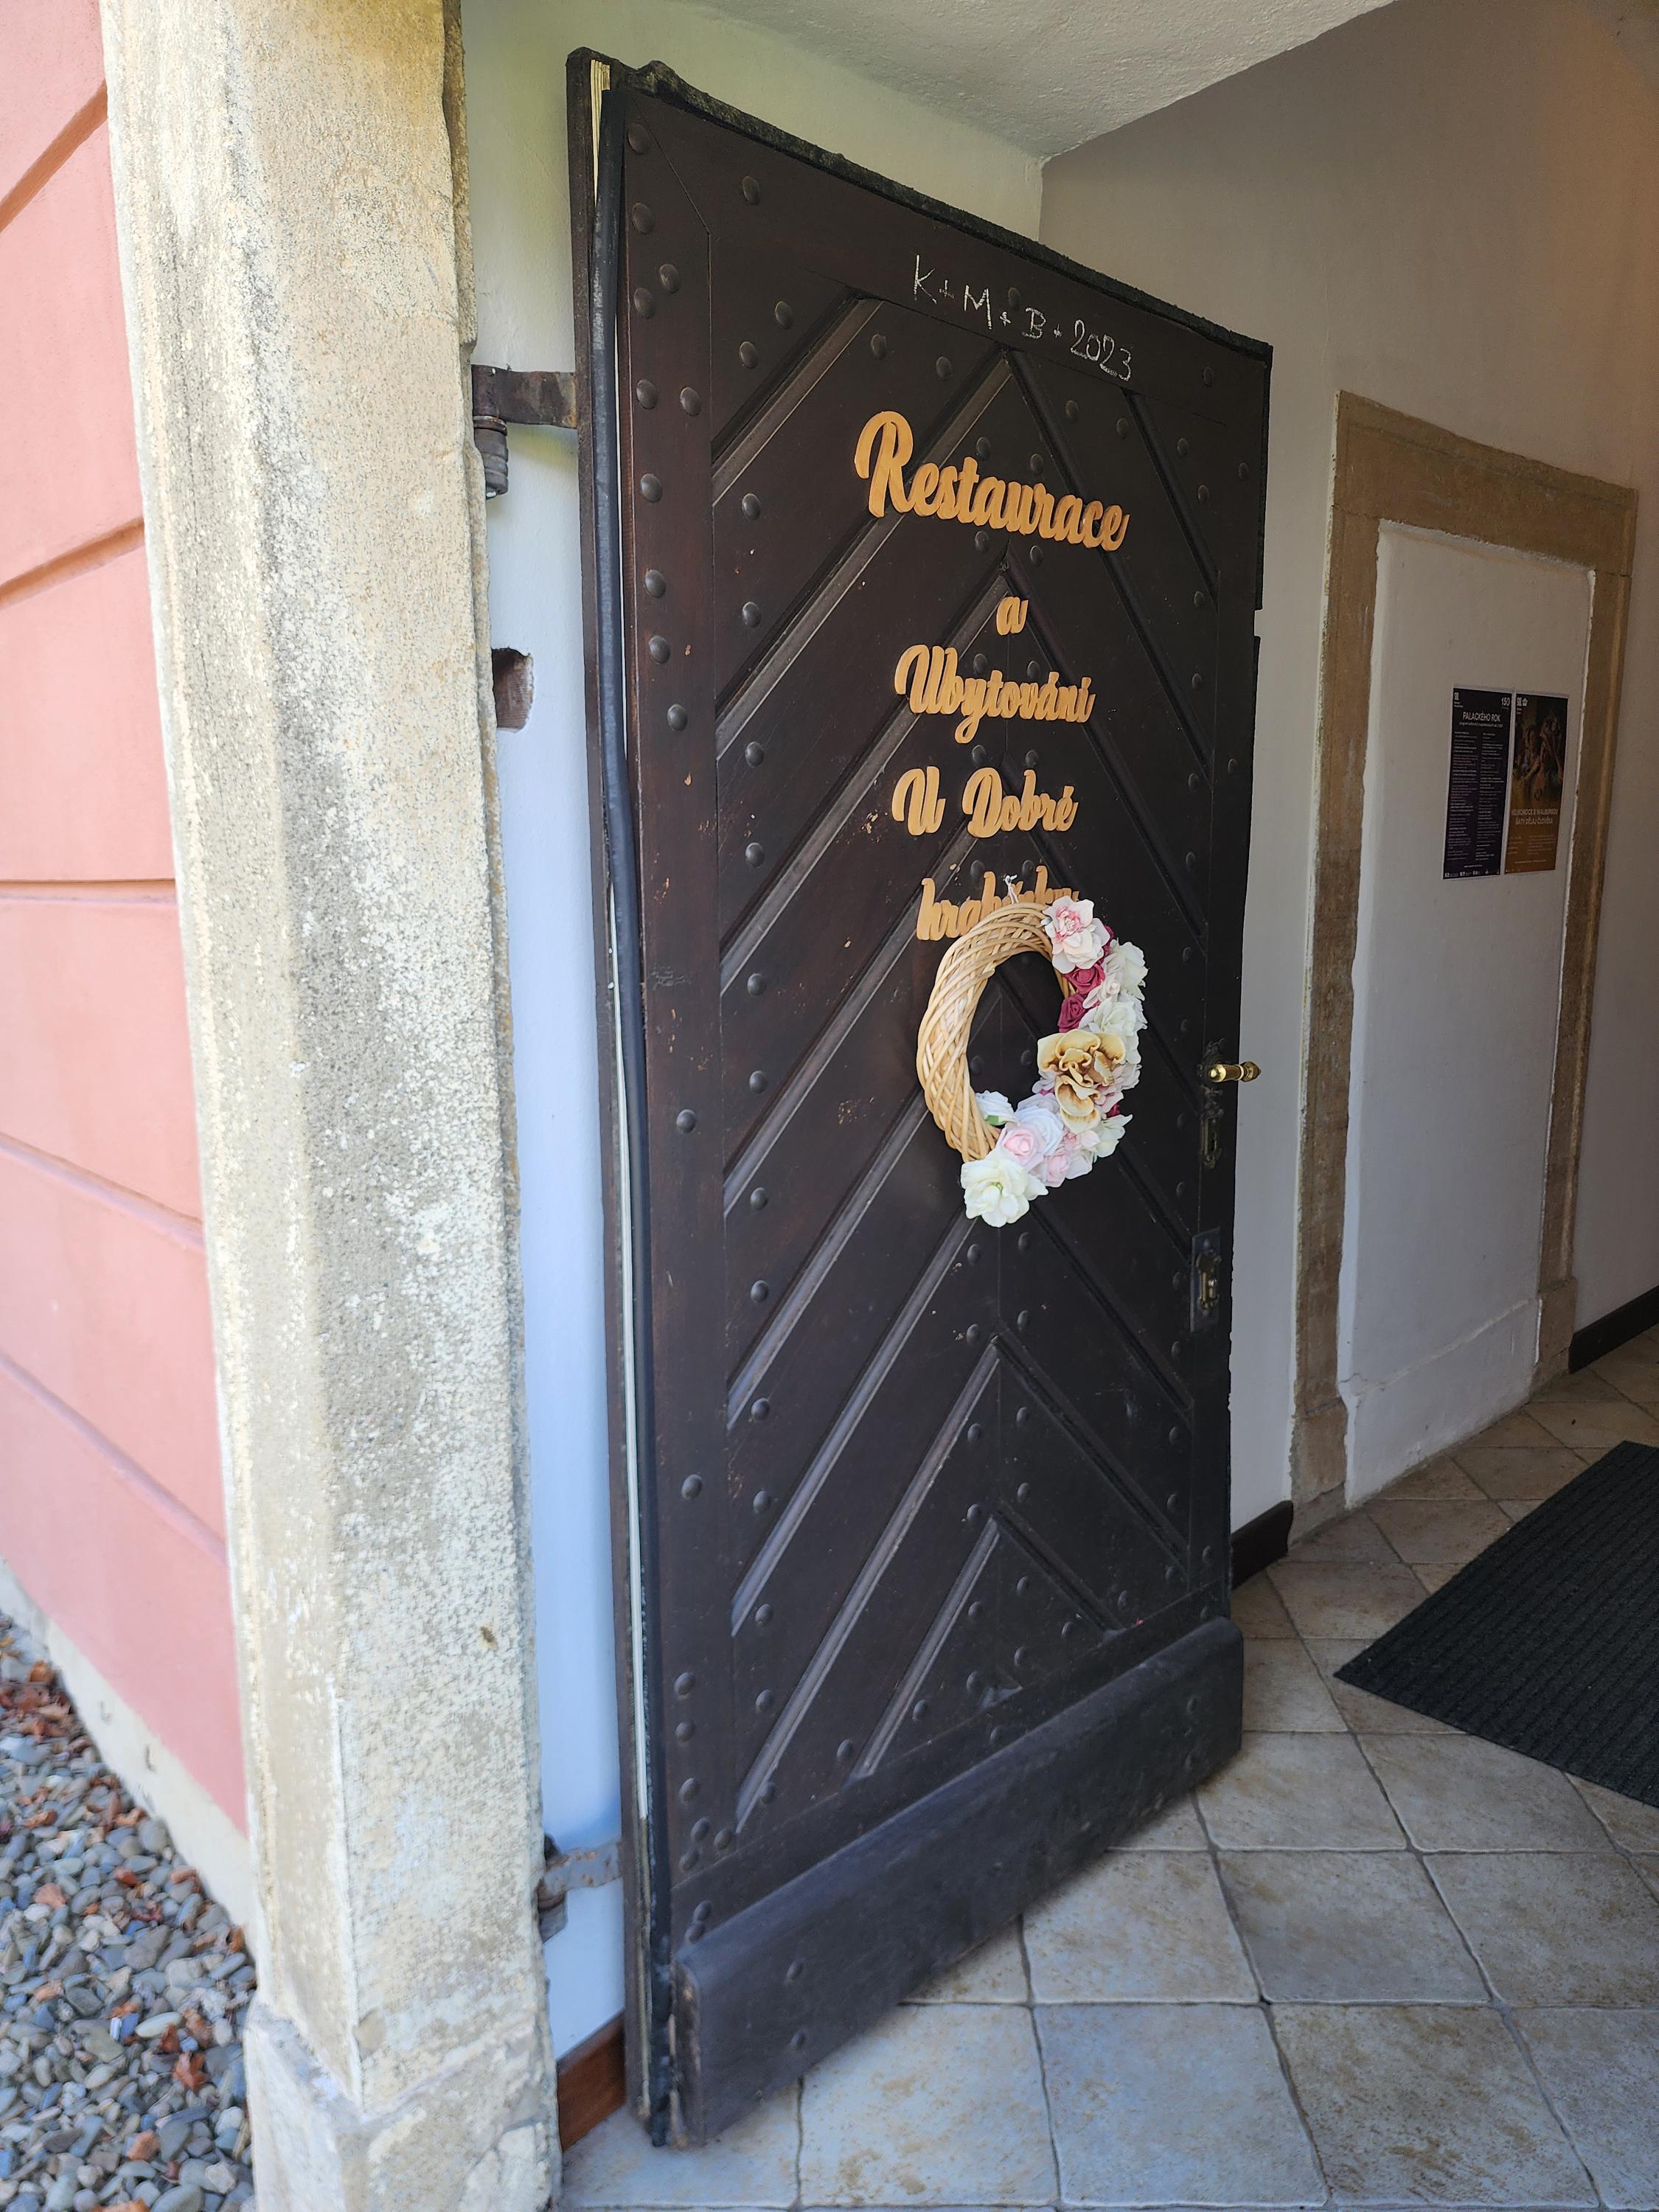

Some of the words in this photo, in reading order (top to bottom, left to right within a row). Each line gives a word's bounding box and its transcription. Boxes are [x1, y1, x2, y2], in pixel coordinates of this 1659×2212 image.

[1069, 319, 1132, 381] 2023
[854, 411, 1130, 552] Restaurace
[996, 596, 1029, 636] a
[894, 644, 1096, 744] Ubytování
[1491, 713, 1501, 722] ROK
[891, 765, 947, 836] U
[961, 766, 1079, 838] Dobré
